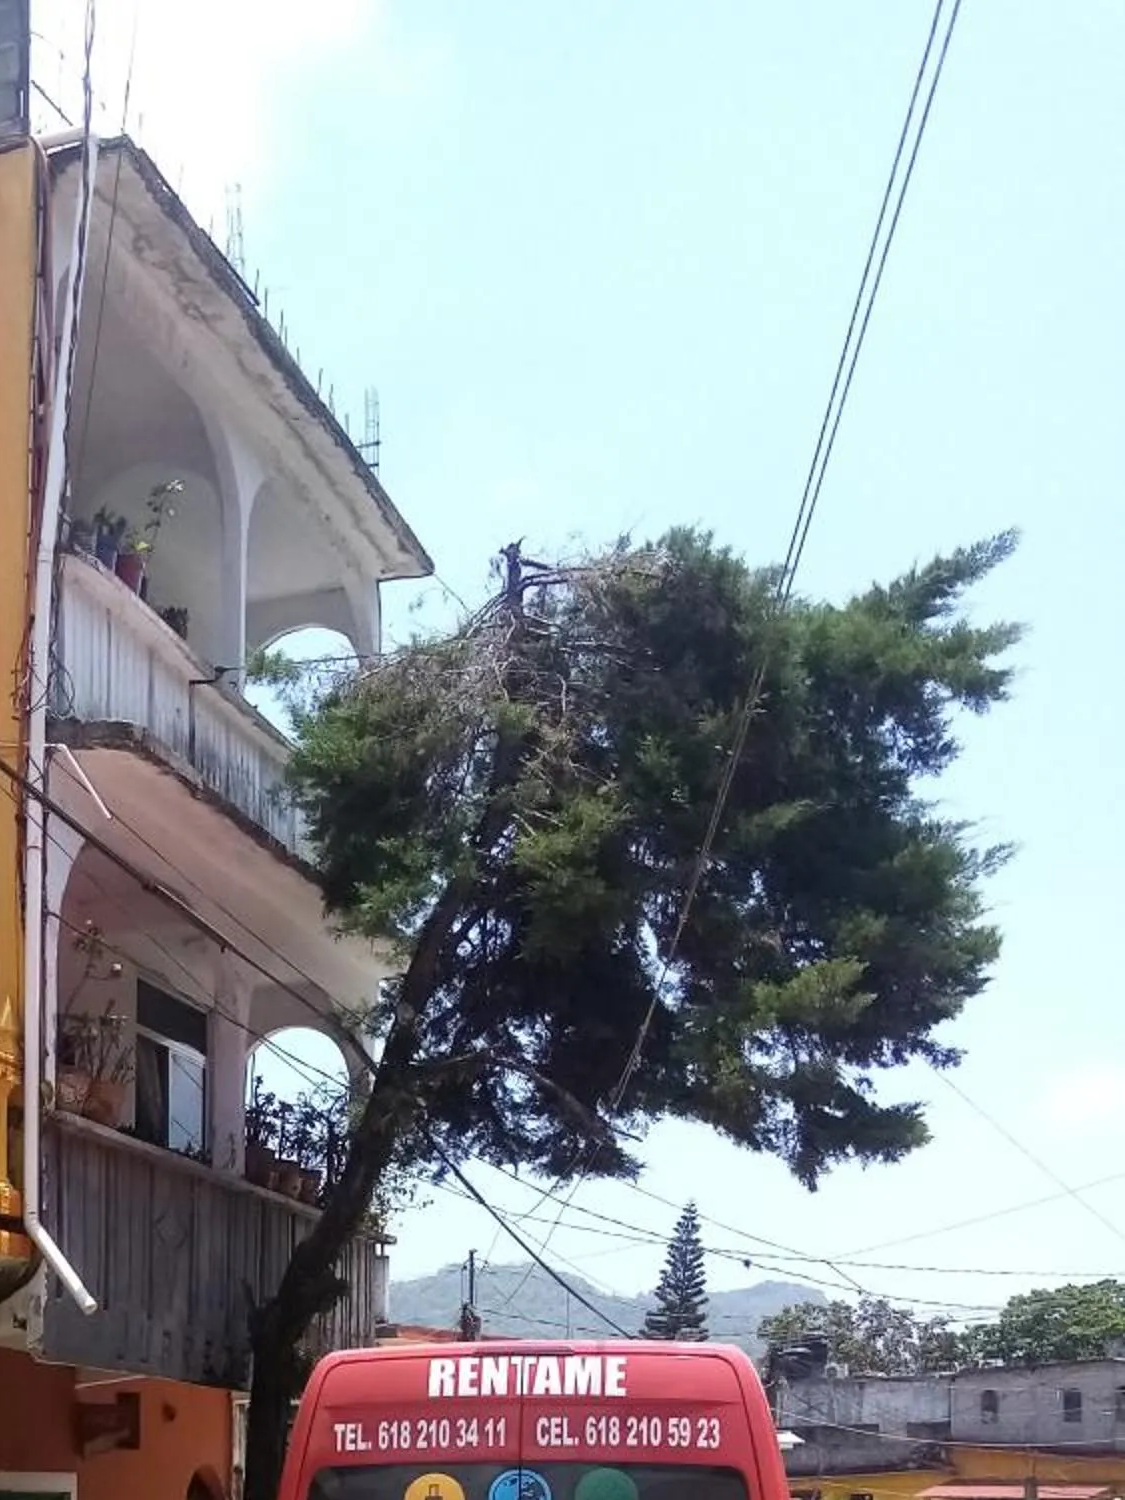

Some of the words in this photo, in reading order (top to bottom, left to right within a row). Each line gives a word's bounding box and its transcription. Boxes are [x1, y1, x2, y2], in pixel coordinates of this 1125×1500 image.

[427, 1356, 627, 1398] RENTAME
[334, 1422, 372, 1451] TEL.
[378, 1420, 411, 1450] 618
[416, 1419, 450, 1449] 210
[456, 1418, 479, 1448] 34
[484, 1417, 507, 1447] 11
[536, 1417, 579, 1448] CEL.
[585, 1416, 620, 1446] 618
[626, 1416, 662, 1447] 210
[667, 1417, 692, 1447] 59
[696, 1418, 721, 1449] 23
